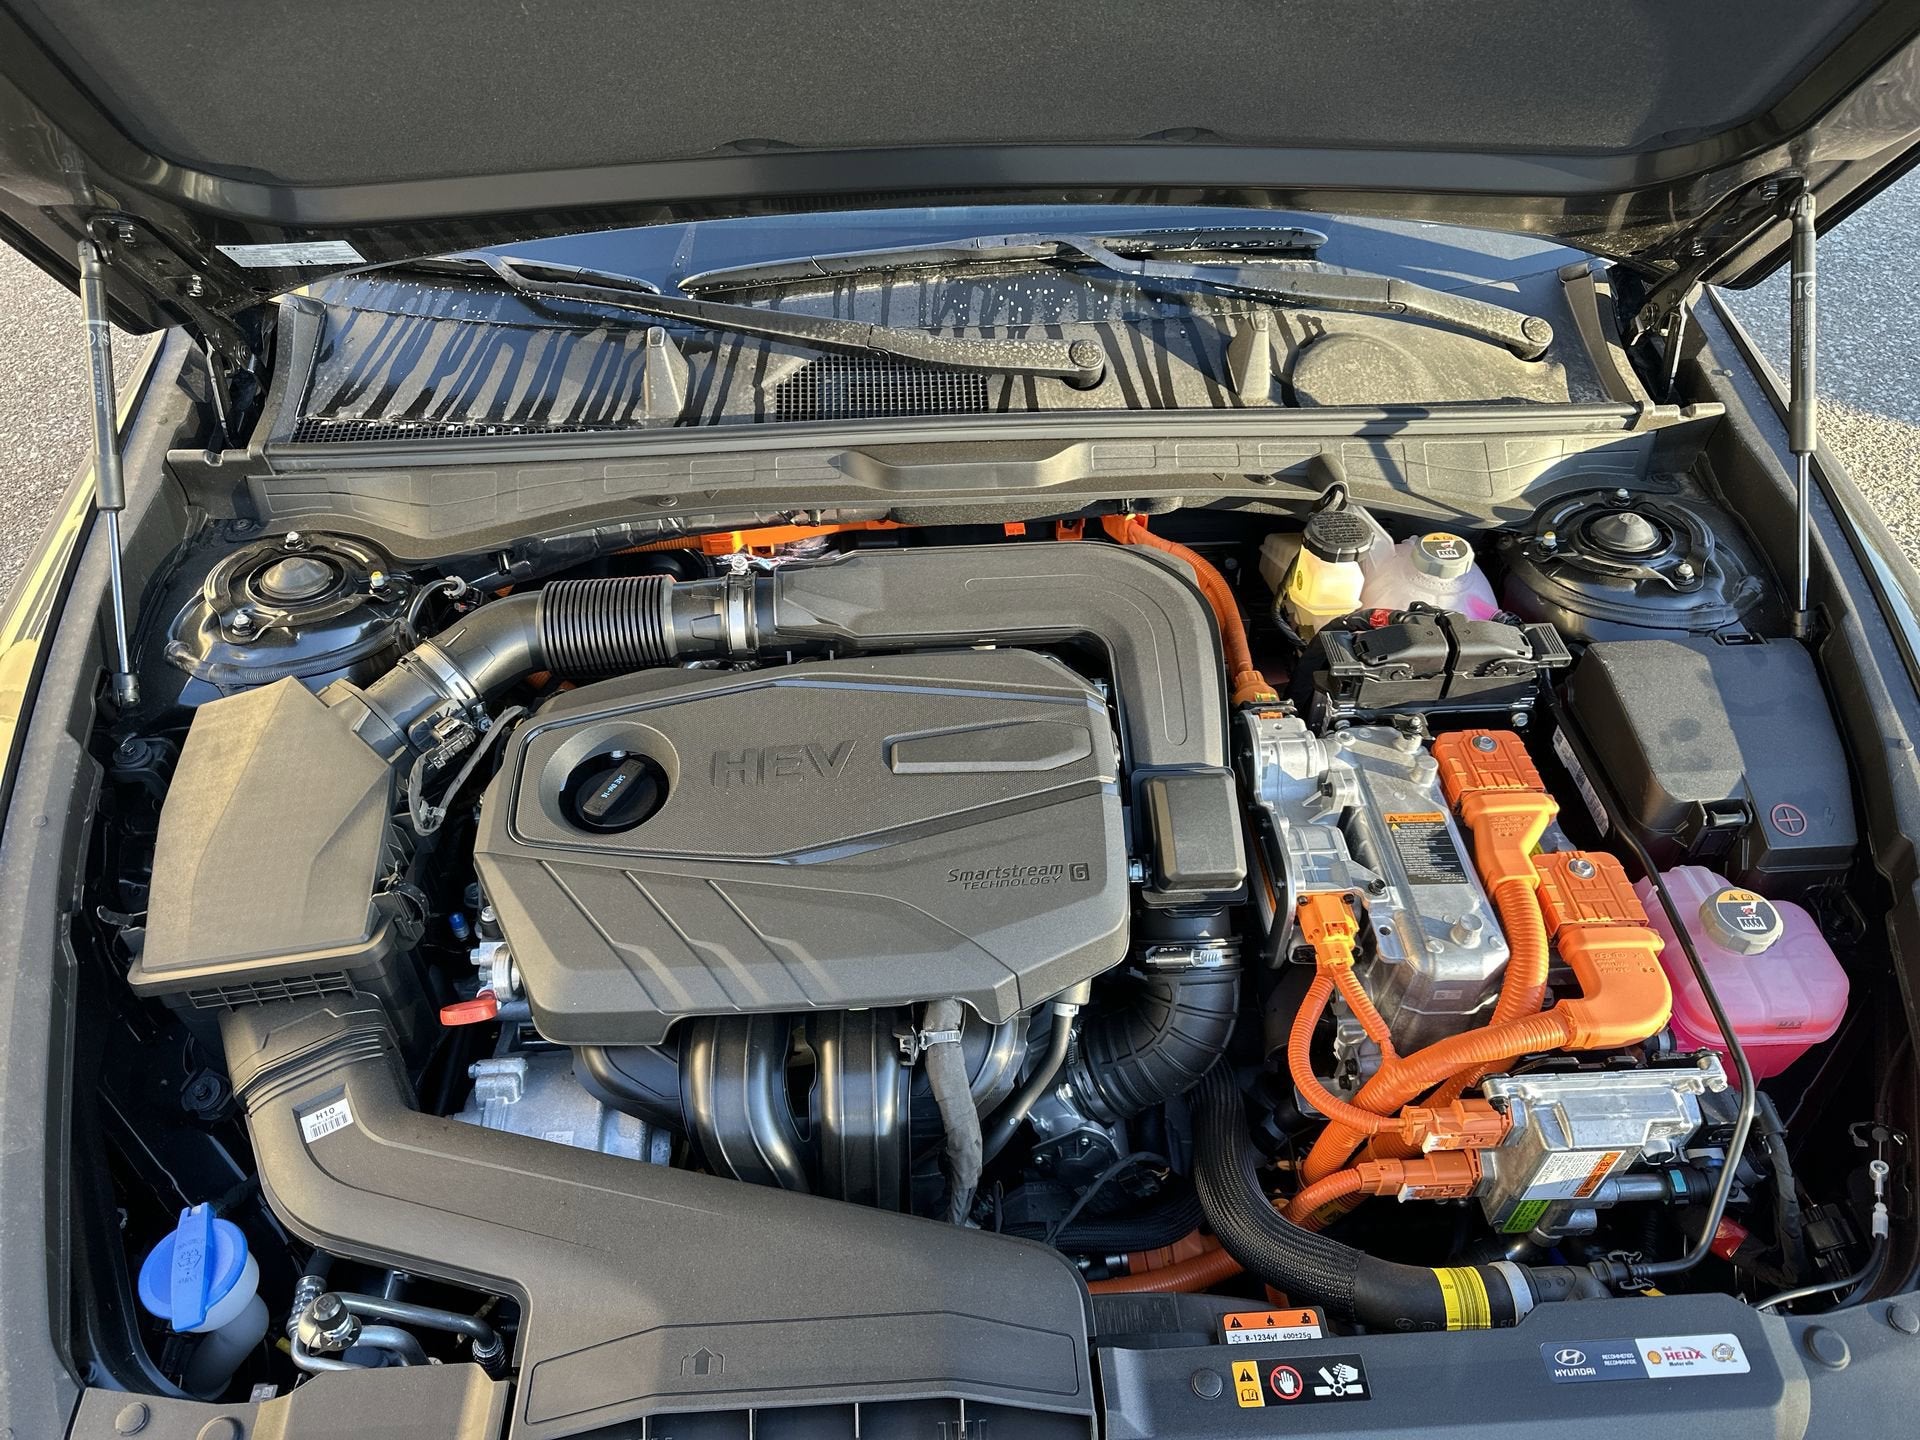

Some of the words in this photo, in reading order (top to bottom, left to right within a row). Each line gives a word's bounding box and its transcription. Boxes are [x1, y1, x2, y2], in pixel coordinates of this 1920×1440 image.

[710, 739, 858, 787] HEV
[946, 864, 1064, 883] Smartstream
[962, 875, 1062, 890] TECHNOLOGY
[316, 1107, 335, 1121] H10
[1245, 1333, 1278, 1342] R-1234yf
[1664, 1350, 1703, 1361] HELIX
[1554, 1367, 1597, 1377] HYUNDAI
